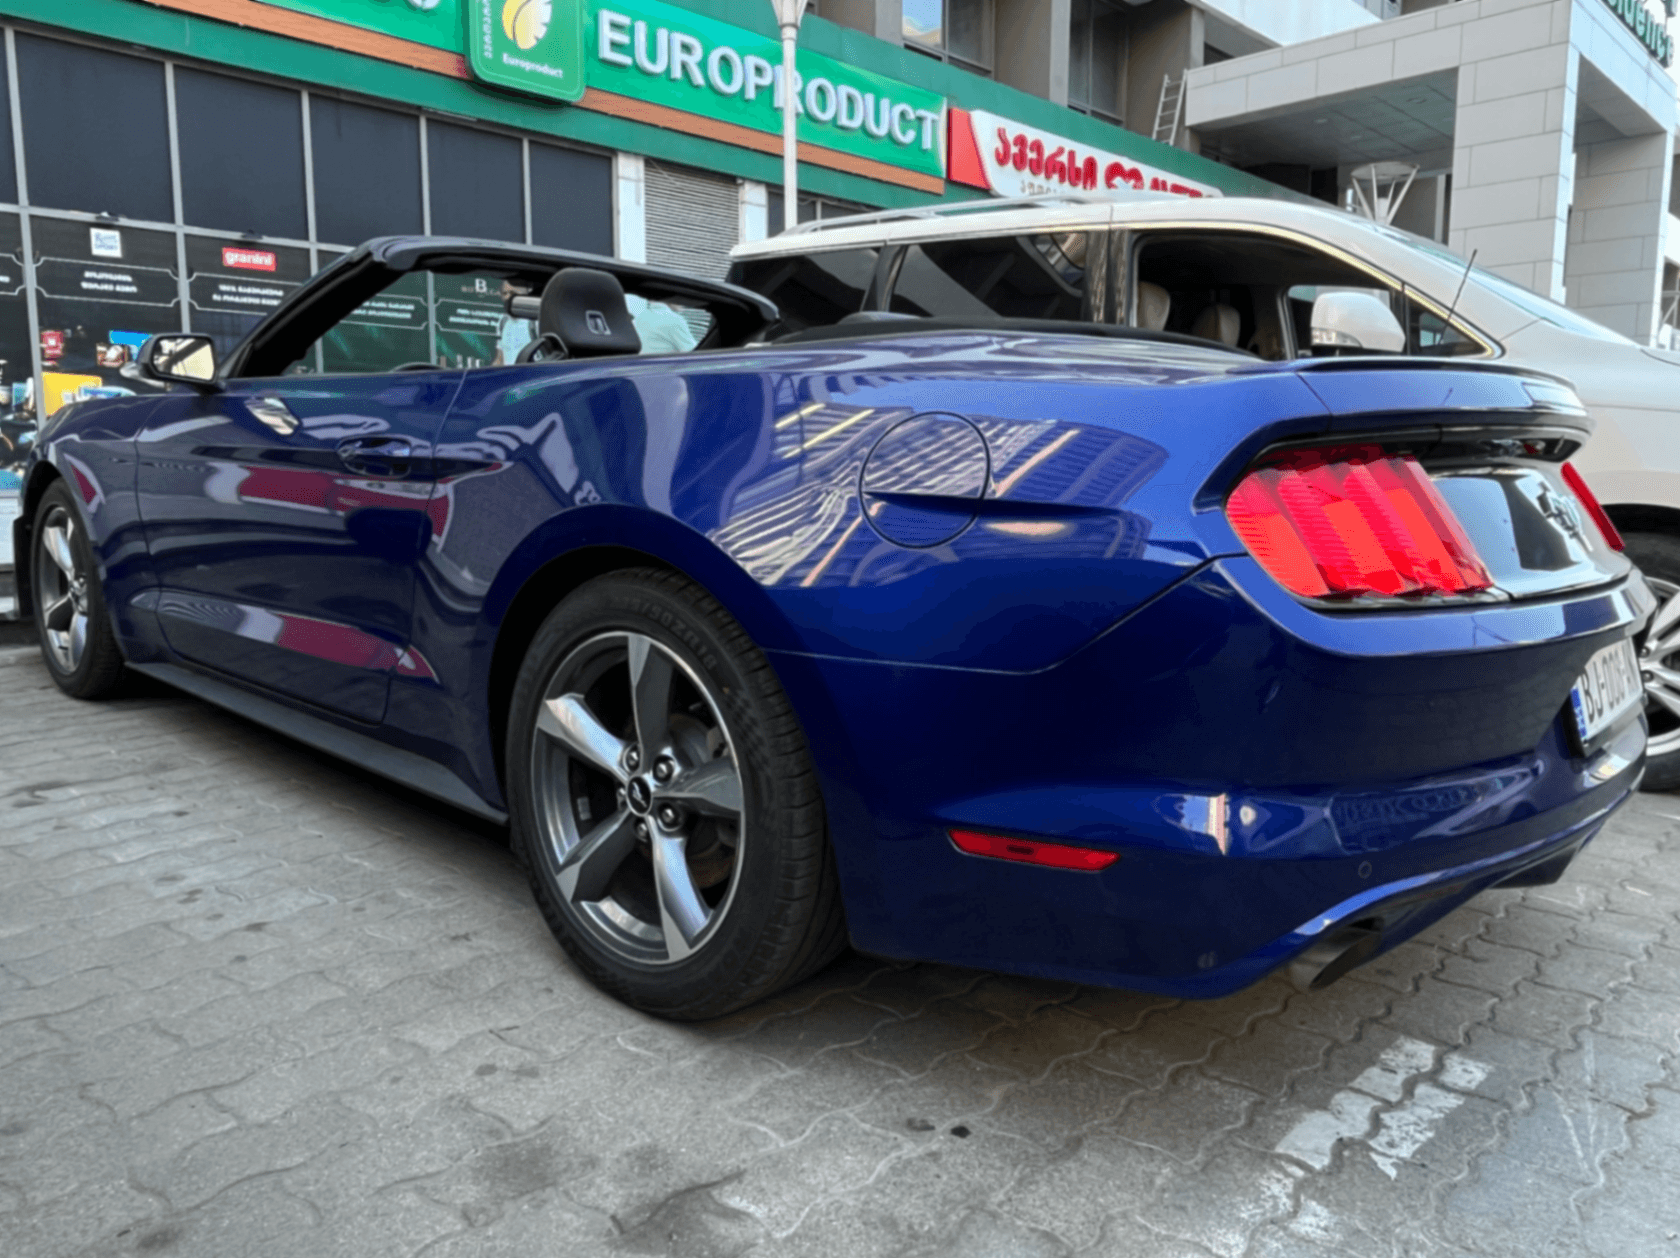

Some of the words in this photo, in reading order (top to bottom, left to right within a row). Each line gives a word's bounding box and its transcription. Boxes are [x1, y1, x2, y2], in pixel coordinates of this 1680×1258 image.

[502, 52, 564, 79] Europroduct
[598, 8, 940, 151] EUROPRODUCT
[994, 126, 1098, 191] ავერსი
[224, 251, 273, 267] granini
